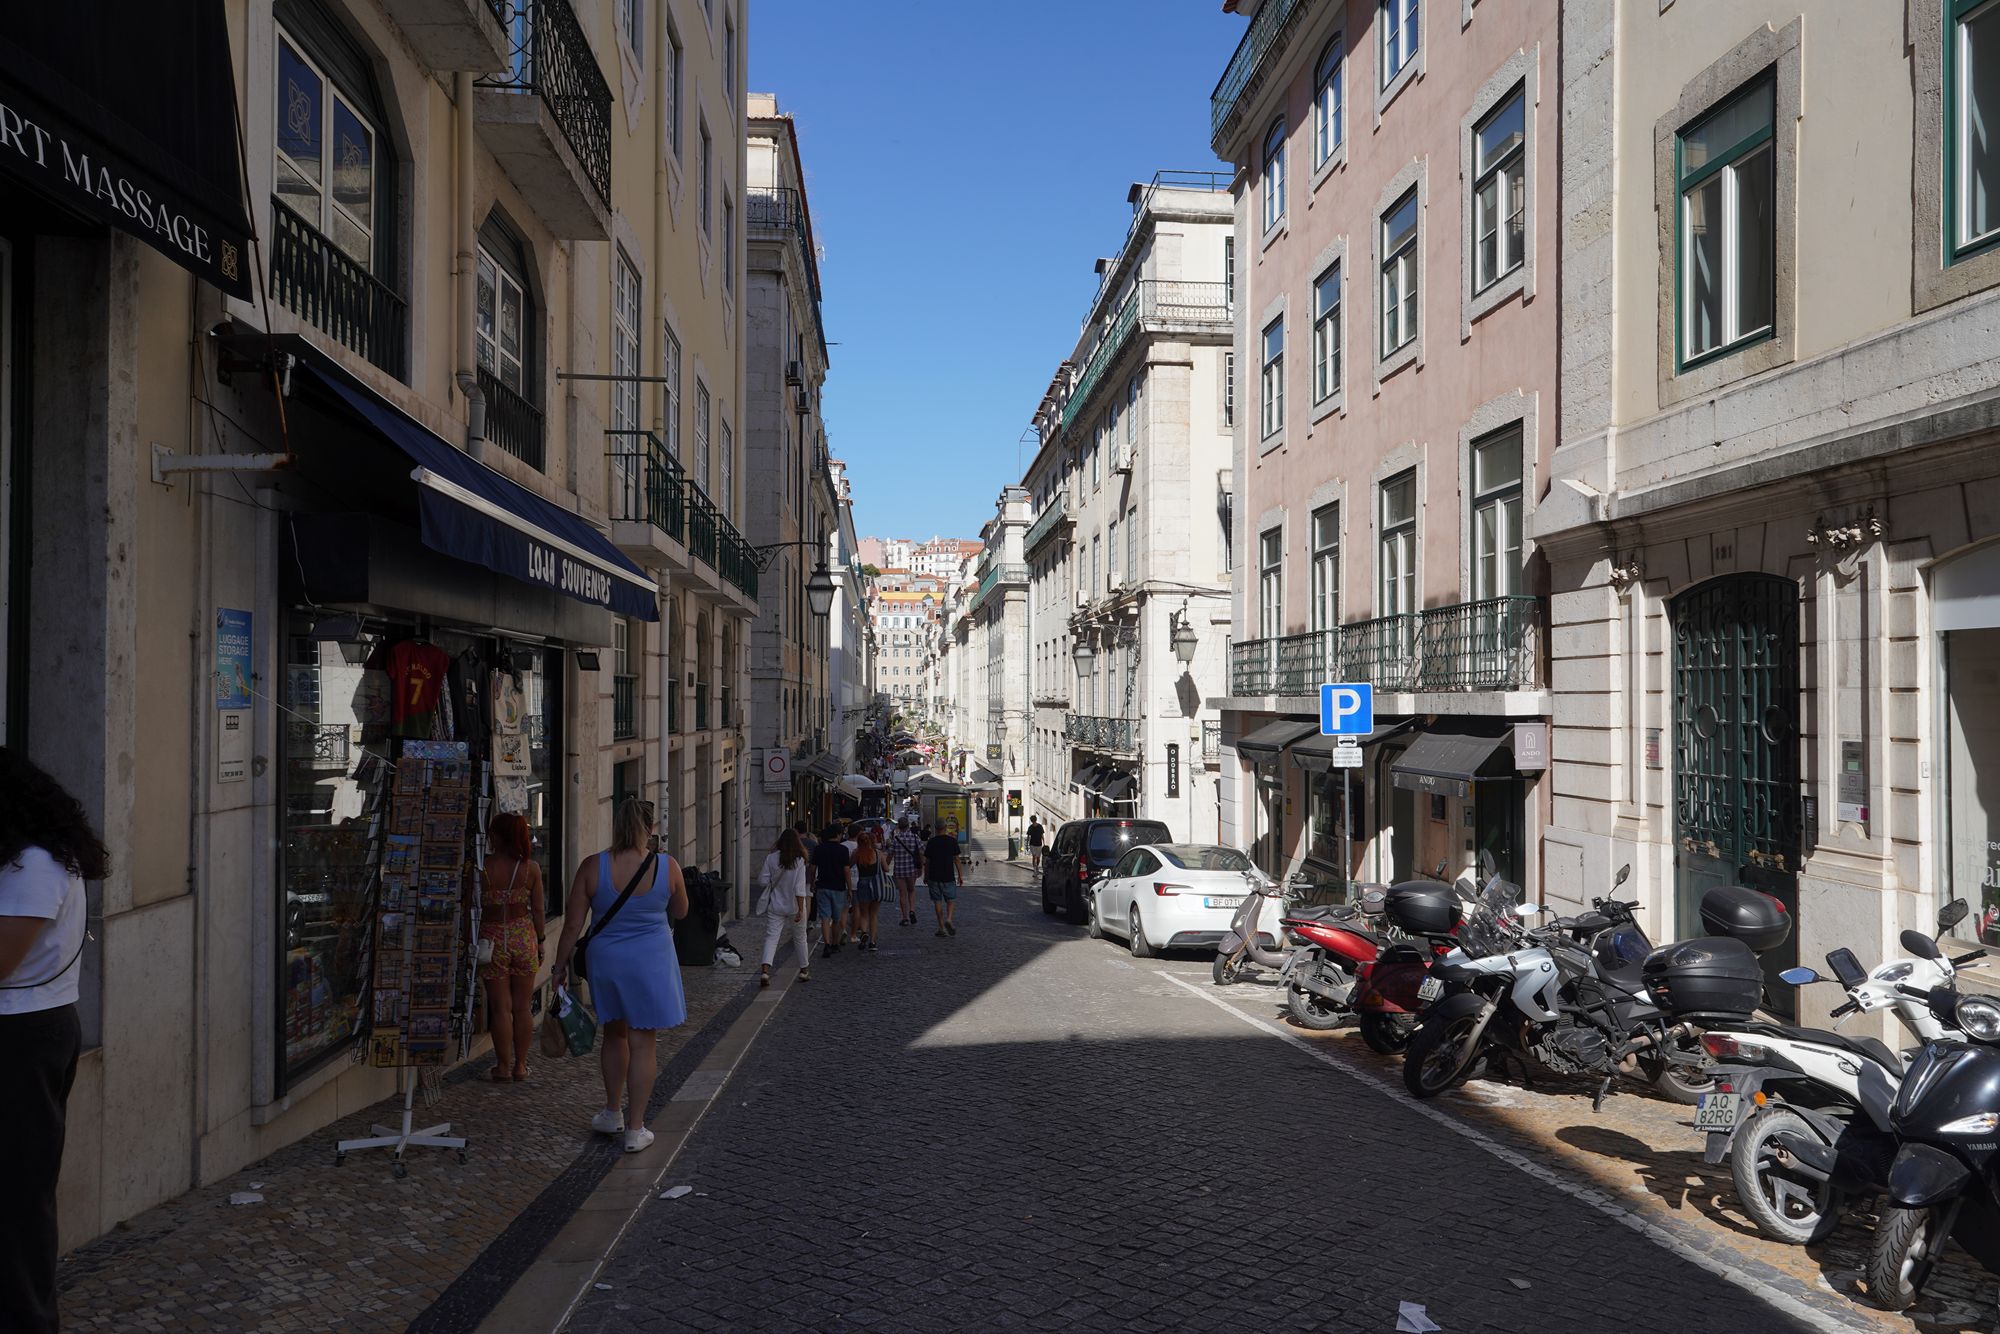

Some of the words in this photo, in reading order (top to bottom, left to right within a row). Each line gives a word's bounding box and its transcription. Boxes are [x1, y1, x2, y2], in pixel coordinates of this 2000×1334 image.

[60, 139, 212, 264] MASSAGE
[528, 542, 556, 586] LOJA
[561, 558, 611, 604] SOUVENIRS
[218, 634, 249, 645] LUGGAGE
[218, 645, 249, 656] STORAGE
[410, 677, 424, 705] 7
[1331, 688, 1361, 730] P
[1419, 776, 1436, 786] ANDO
[1709, 1095, 1729, 1109] AQ
[1699, 1109, 1733, 1124] 82RG
[1966, 1142, 1998, 1151] YAMAHA
